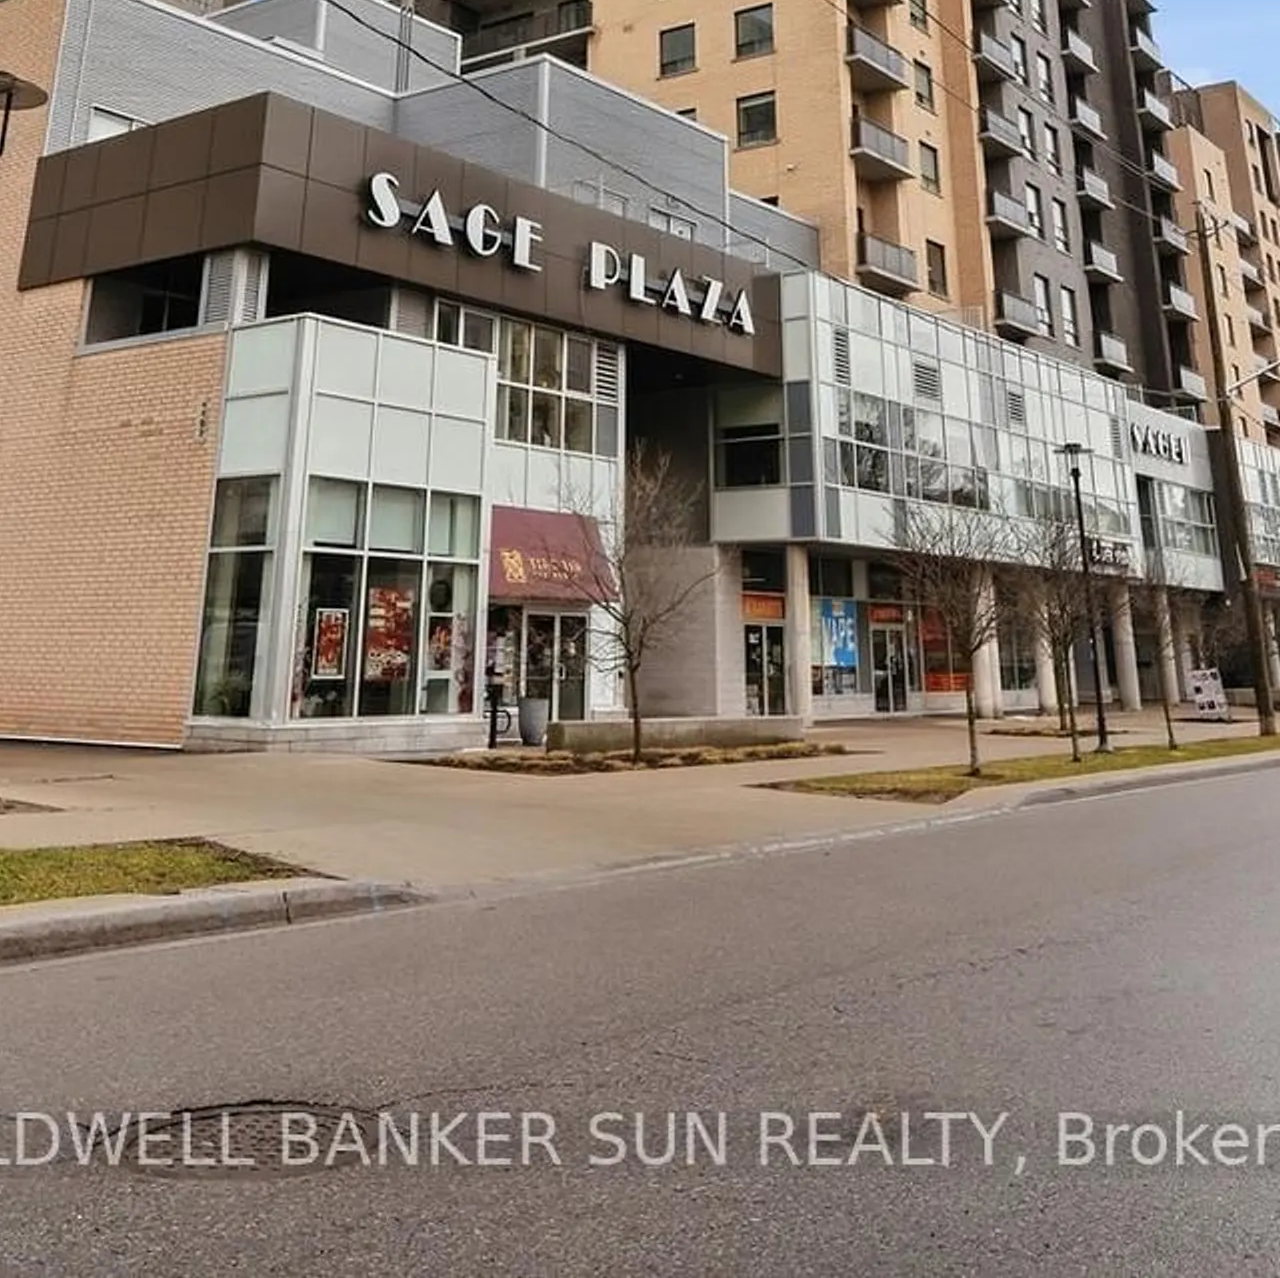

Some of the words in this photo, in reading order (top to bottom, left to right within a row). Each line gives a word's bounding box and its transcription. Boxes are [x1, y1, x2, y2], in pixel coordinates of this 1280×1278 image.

[367, 171, 543, 273] SAGE
[589, 240, 756, 336] PLAZA
[822, 616, 857, 652] VAPE
